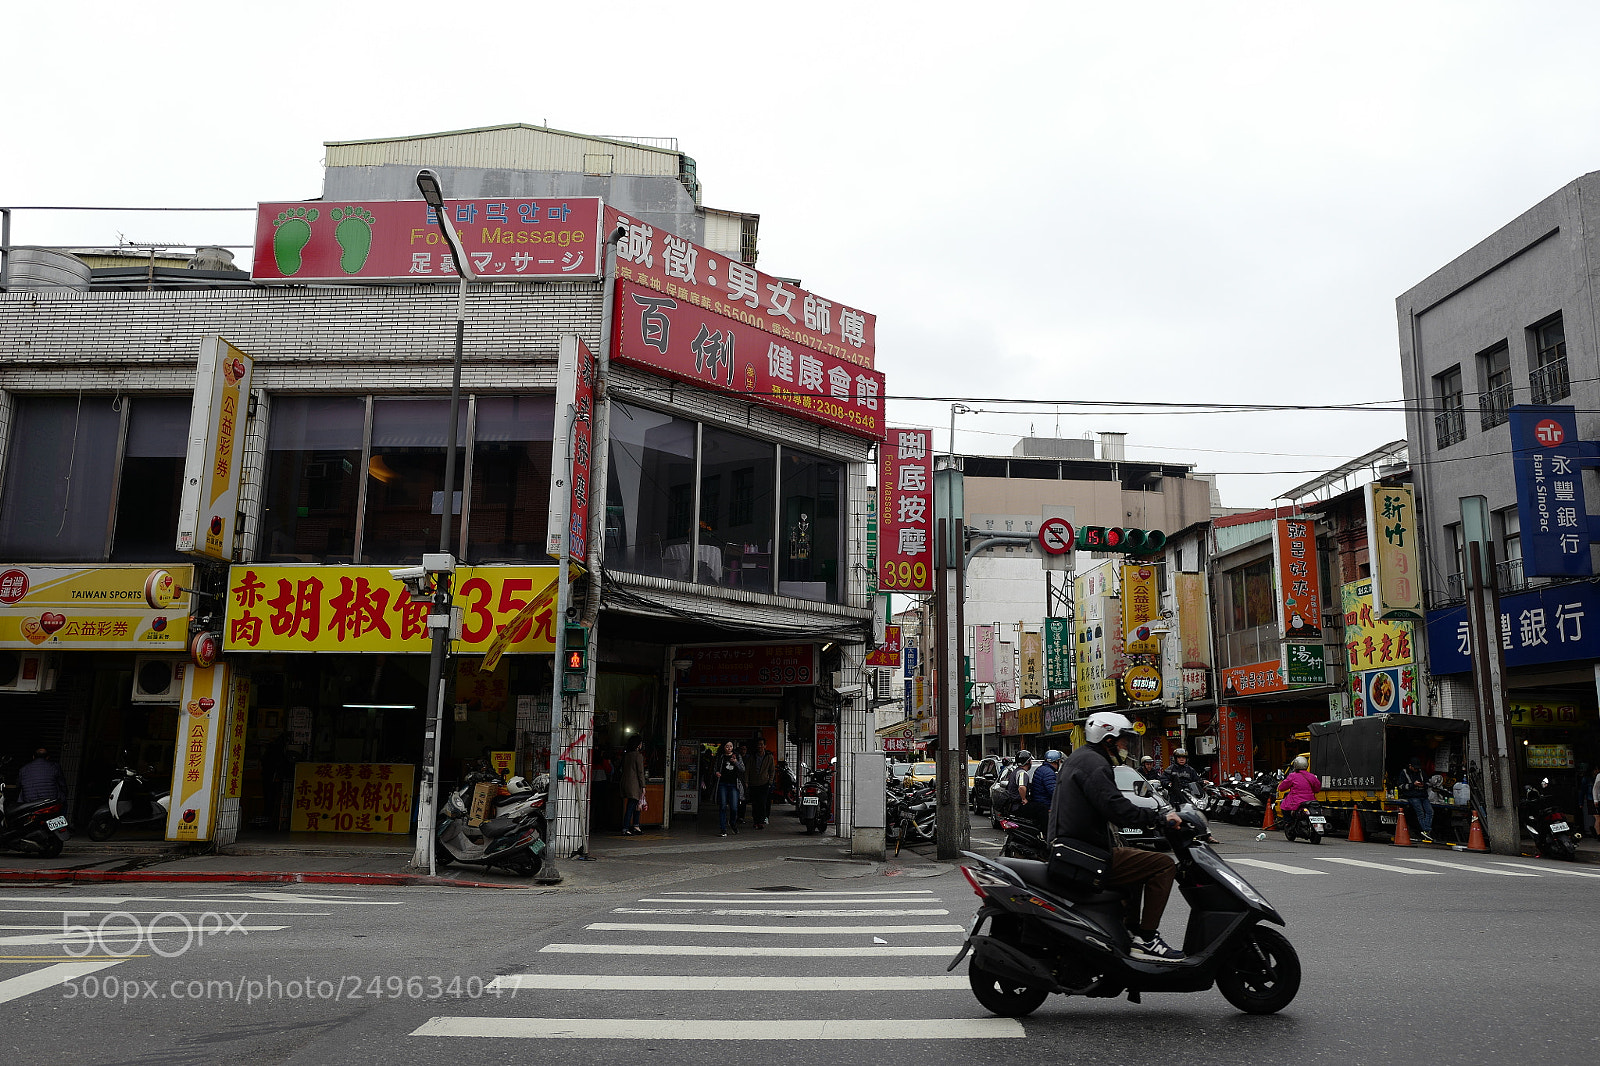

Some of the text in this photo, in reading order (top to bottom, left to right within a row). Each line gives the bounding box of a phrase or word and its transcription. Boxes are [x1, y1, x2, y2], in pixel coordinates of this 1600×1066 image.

[481, 226, 585, 247] Massage
[767, 341, 879, 411] 健康會館
[216, 395, 235, 478] 公益彩券
[884, 454, 893, 525] Foot Massage
[1532, 454, 1550, 533] Bank SinoPac
[1551, 454, 1581, 555] 永豐銀行
[884, 560, 927, 588] 399
[1287, 521, 1309, 597] 就是好夾
[71, 590, 142, 599] TAIWAN SPORTS
[230, 570, 265, 647] 赤肉
[1133, 585, 1150, 623] 公益彩券
[65, 621, 129, 637] 公益彩券
[1345, 629, 1411, 666] 百年老店
[759, 666, 810, 683] $399
[770, 657, 798, 666] 40 min
[1292, 645, 1323, 670] 湯村
[1400, 670, 1414, 715] 新竹
[187, 724, 205, 782] 公益彩券
